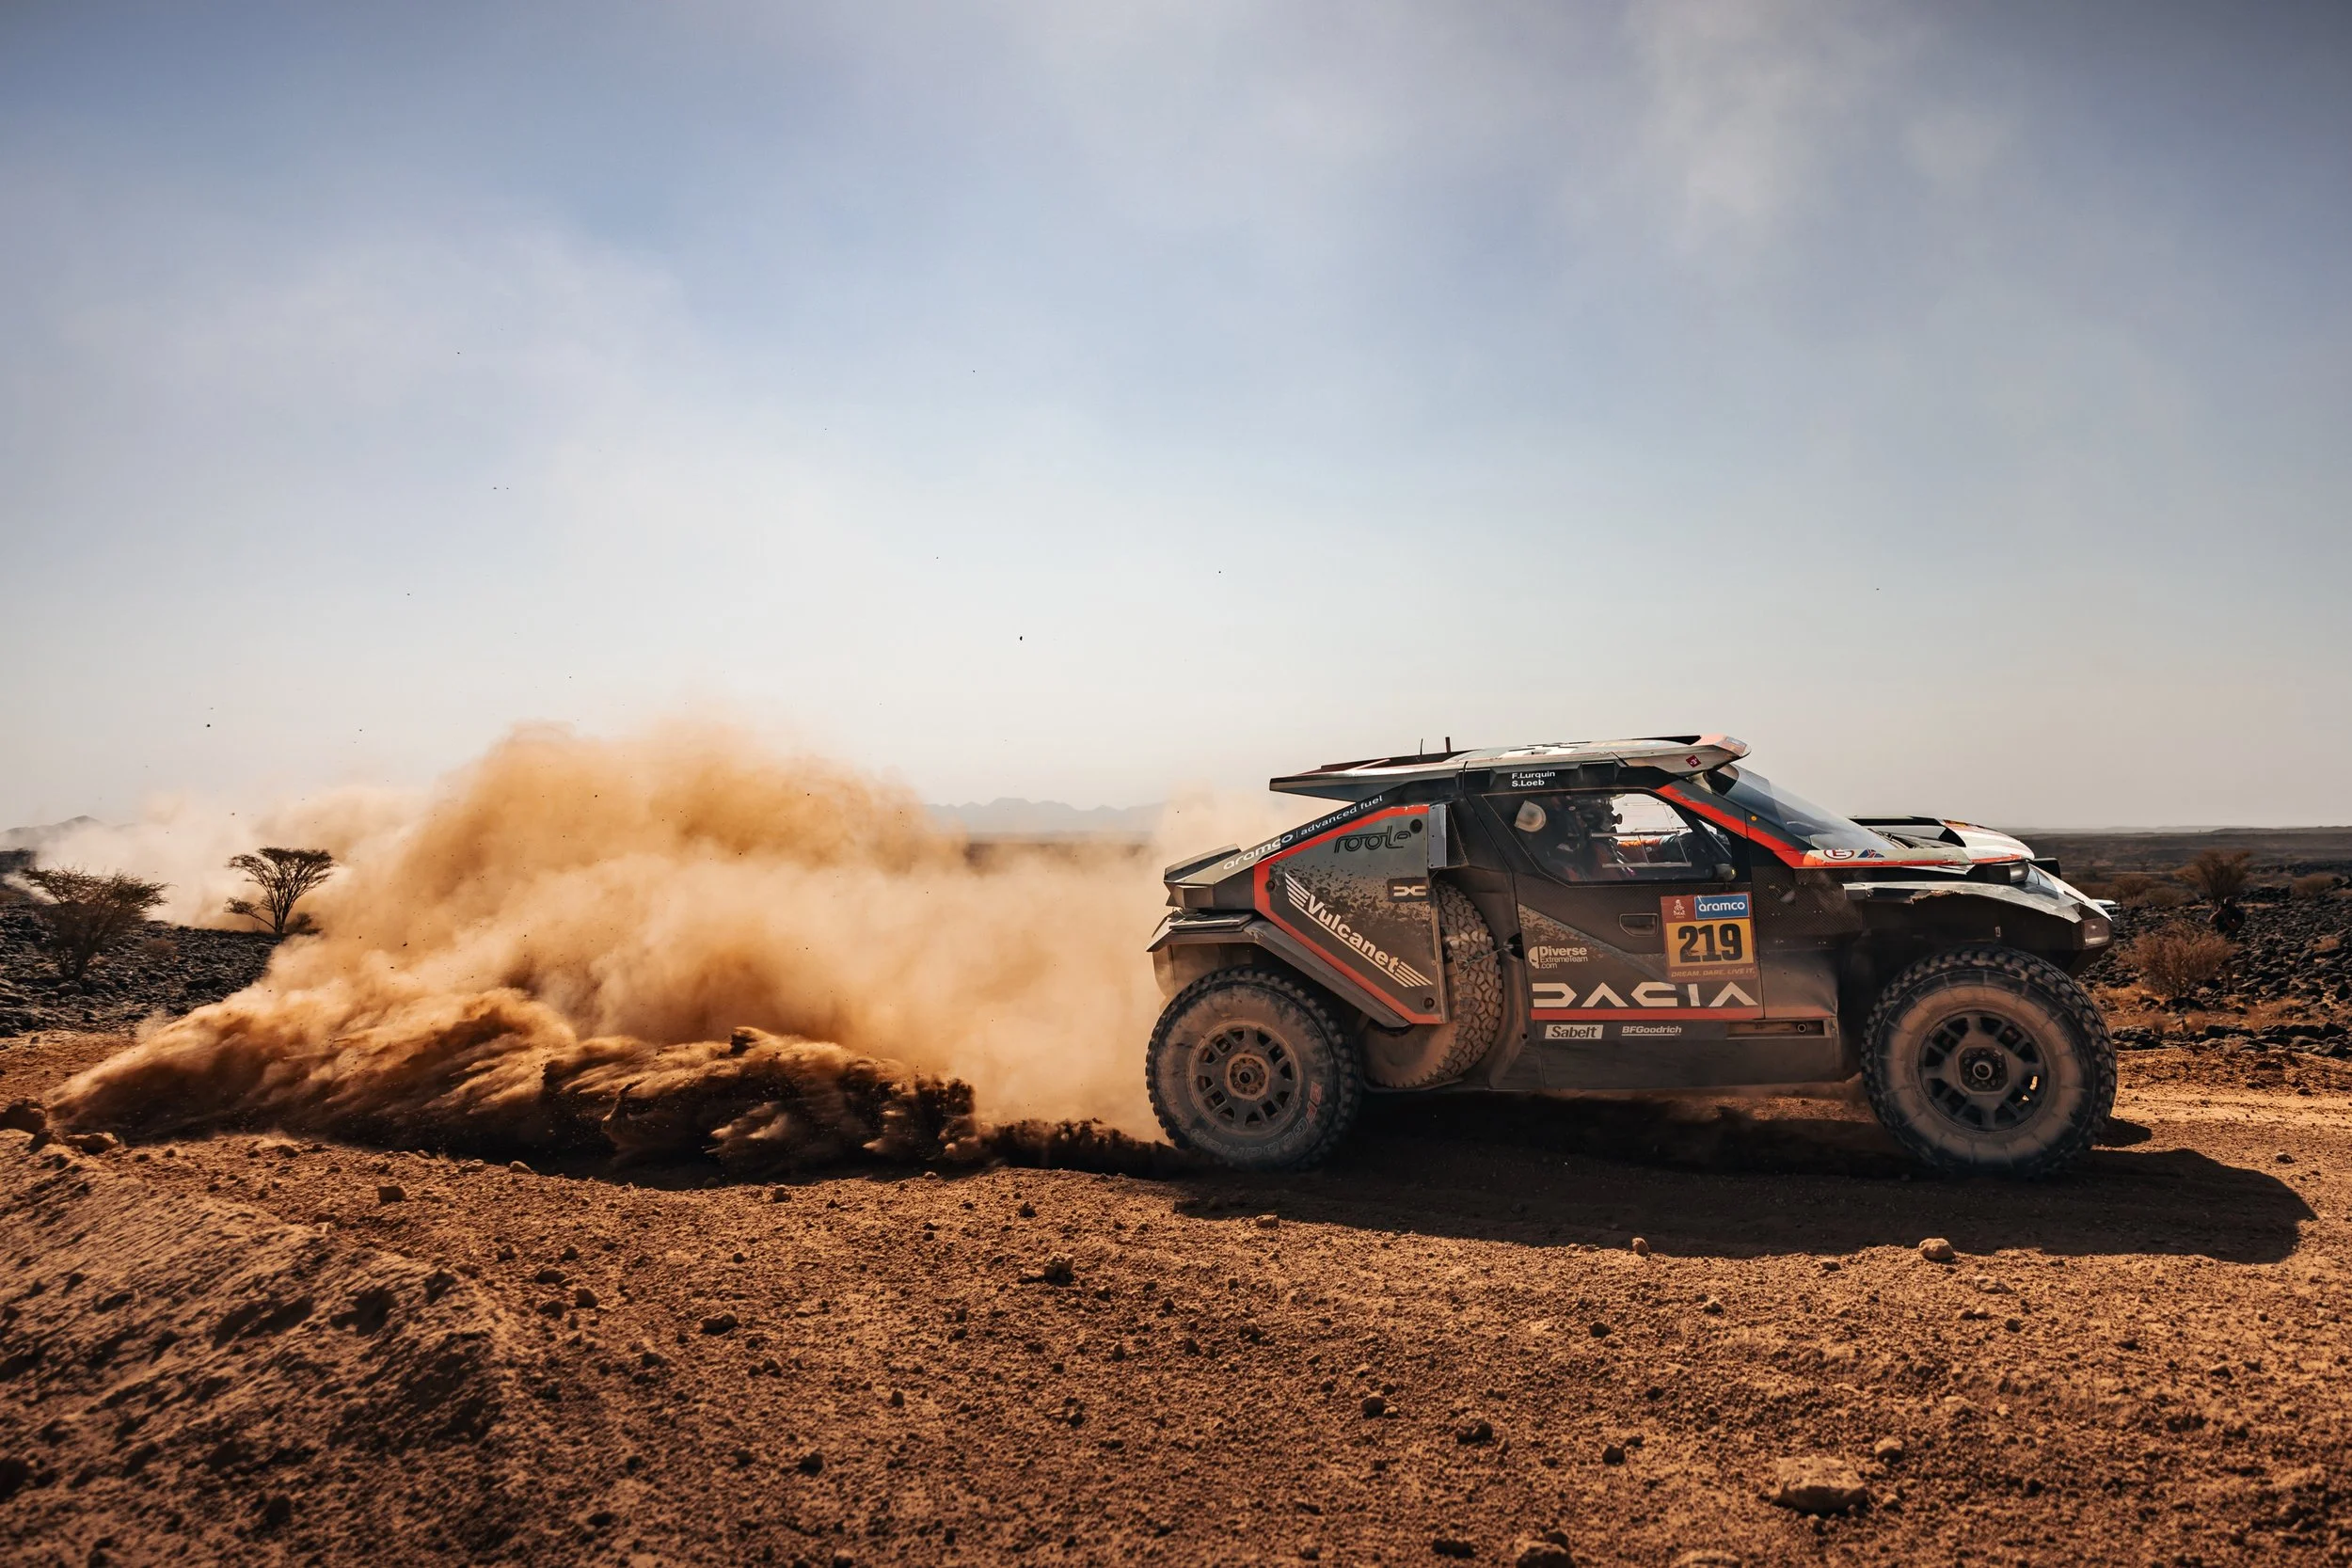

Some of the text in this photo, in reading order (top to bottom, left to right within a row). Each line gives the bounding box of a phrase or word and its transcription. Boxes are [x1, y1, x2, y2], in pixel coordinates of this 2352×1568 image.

[1511, 771, 1556, 780] F.Lurquin
[1511, 779, 1545, 787] S.Loeb
[1223, 795, 1383, 870] aramco advanced fuel
[1698, 902, 1746, 912] aramco
[1307, 894, 1399, 974] Vulcanet
[1677, 923, 1743, 963] 219
[1539, 945, 1587, 957] Diverse
[1540, 956, 1589, 964] ExtremeTeam
[1532, 981, 1759, 1007] DACIA
[1550, 1025, 1597, 1038] Sabelt
[1621, 1025, 1682, 1034] BFGoodrich
